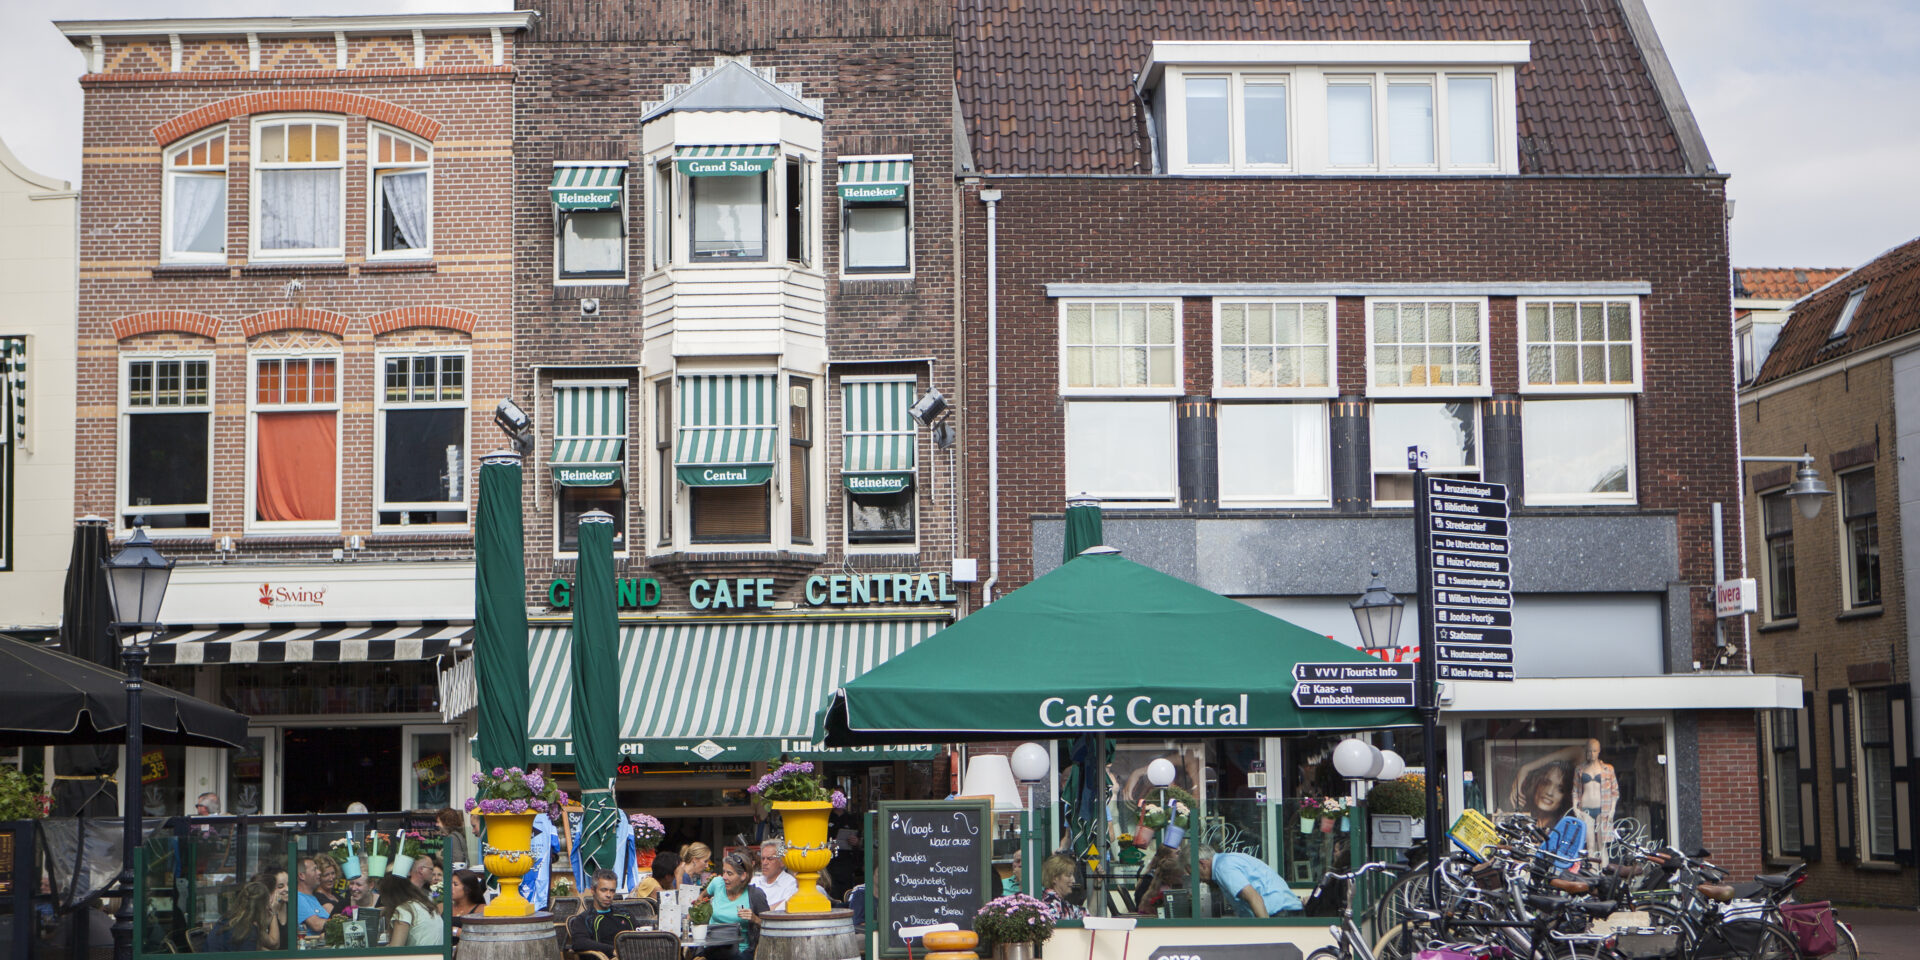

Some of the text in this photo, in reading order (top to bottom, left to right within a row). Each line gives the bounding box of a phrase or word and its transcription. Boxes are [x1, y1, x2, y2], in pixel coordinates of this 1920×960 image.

[689, 161, 761, 172] Grand Salon
[844, 187, 897, 197] Heineken
[558, 193, 611, 203] Heineken
[560, 470, 612, 480] Heineken
[703, 469, 747, 480] Central
[849, 477, 902, 488] Heineken
[1444, 502, 1479, 513] Bibliotheek
[1445, 520, 1487, 531] Streekarchief
[1445, 539, 1454, 547] De
[1490, 542, 1504, 551] Dom
[1446, 557, 1499, 571] Huize Groeneweg
[276, 586, 324, 606] Swing
[548, 572, 957, 609] GND CAFE CENTRAL
[1717, 585, 1741, 604] livera
[1448, 594, 1470, 603] Willem
[1449, 612, 1494, 625] Joodse Poortje
[1449, 631, 1483, 640] Stadsmuur
[1315, 668, 1338, 677] VVV
[1379, 667, 1397, 677] Info
[1451, 668, 1467, 677] Klein
[1468, 669, 1494, 678] Amerika
[1313, 684, 1352, 694] Kaas- en
[1313, 695, 1406, 704] Ambachtenmuseum
[1039, 693, 1248, 727] Café Central
[532, 743, 557, 756] en
[896, 851, 927, 864] Broodjes
[935, 861, 968, 876] Soepen
[899, 873, 946, 888] Dagschotels
[941, 905, 964, 916] Bieren
